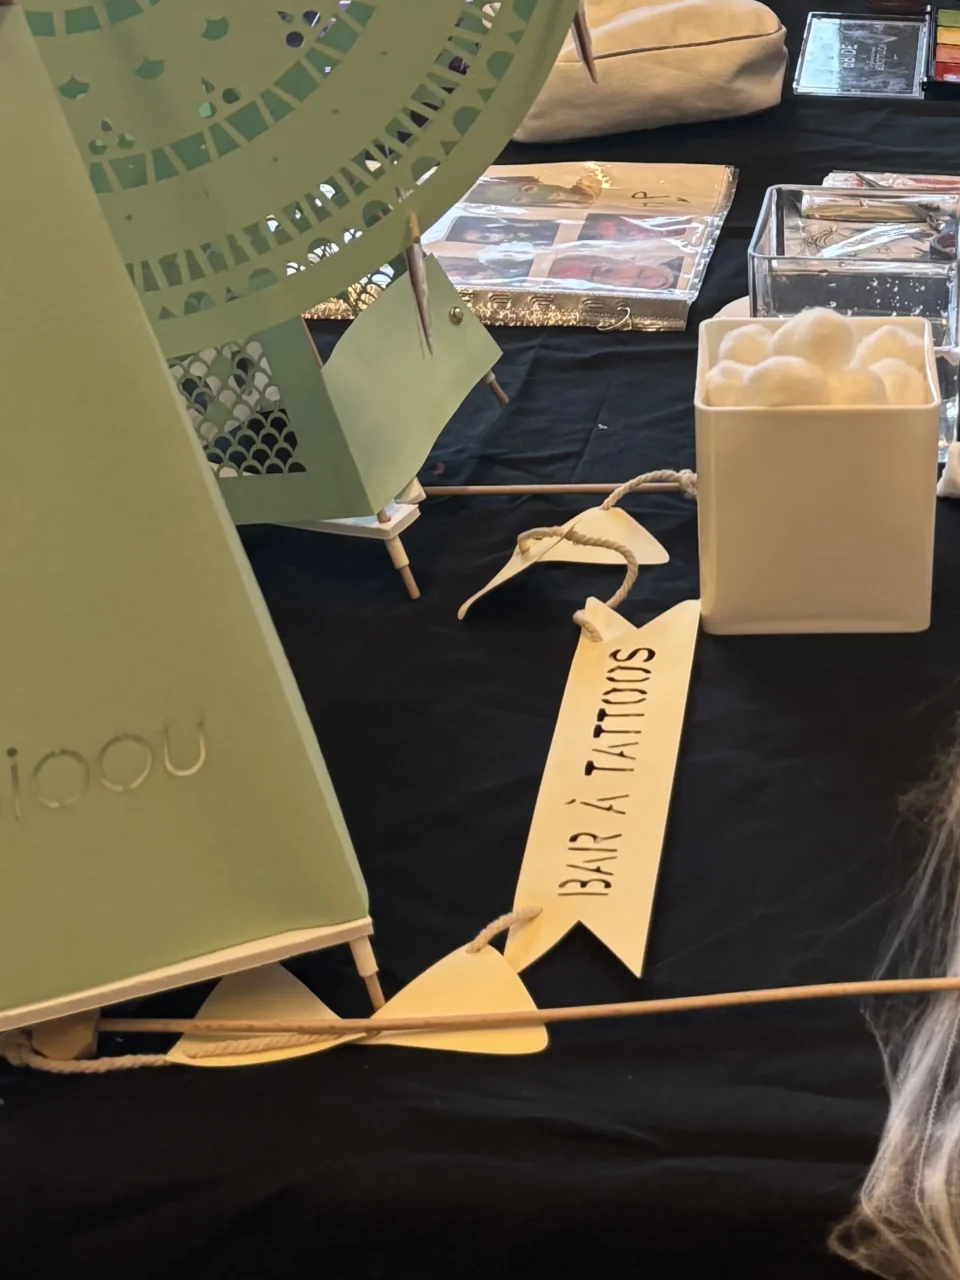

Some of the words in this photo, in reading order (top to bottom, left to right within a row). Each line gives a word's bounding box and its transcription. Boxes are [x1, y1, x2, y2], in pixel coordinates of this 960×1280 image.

[584, 647, 656, 776] TATTOOS
[564, 794, 629, 815] À
[558, 832, 622, 896] BAR
